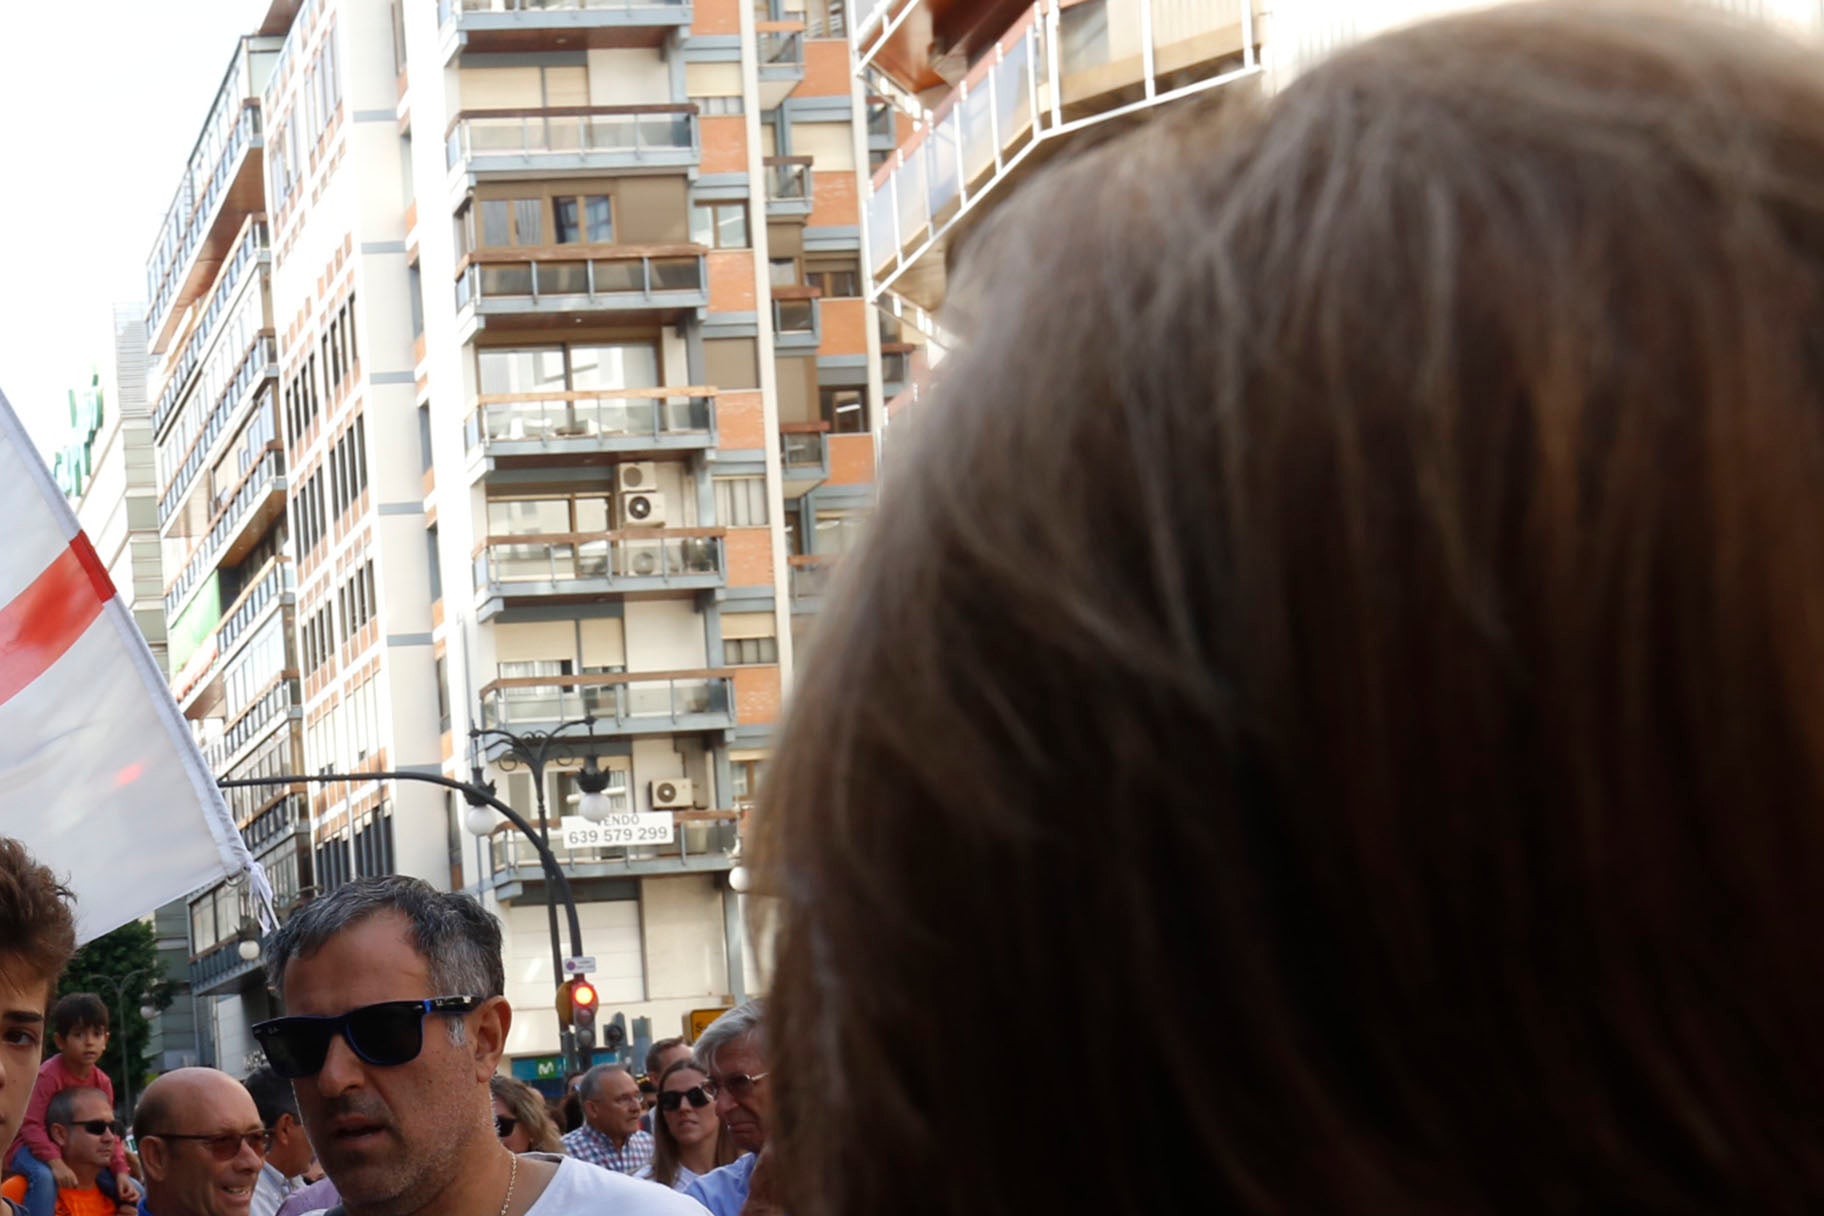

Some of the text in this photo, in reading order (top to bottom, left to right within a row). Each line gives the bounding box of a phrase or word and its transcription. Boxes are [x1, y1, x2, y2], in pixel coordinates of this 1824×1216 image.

[569, 826, 669, 844] 639 579 299
